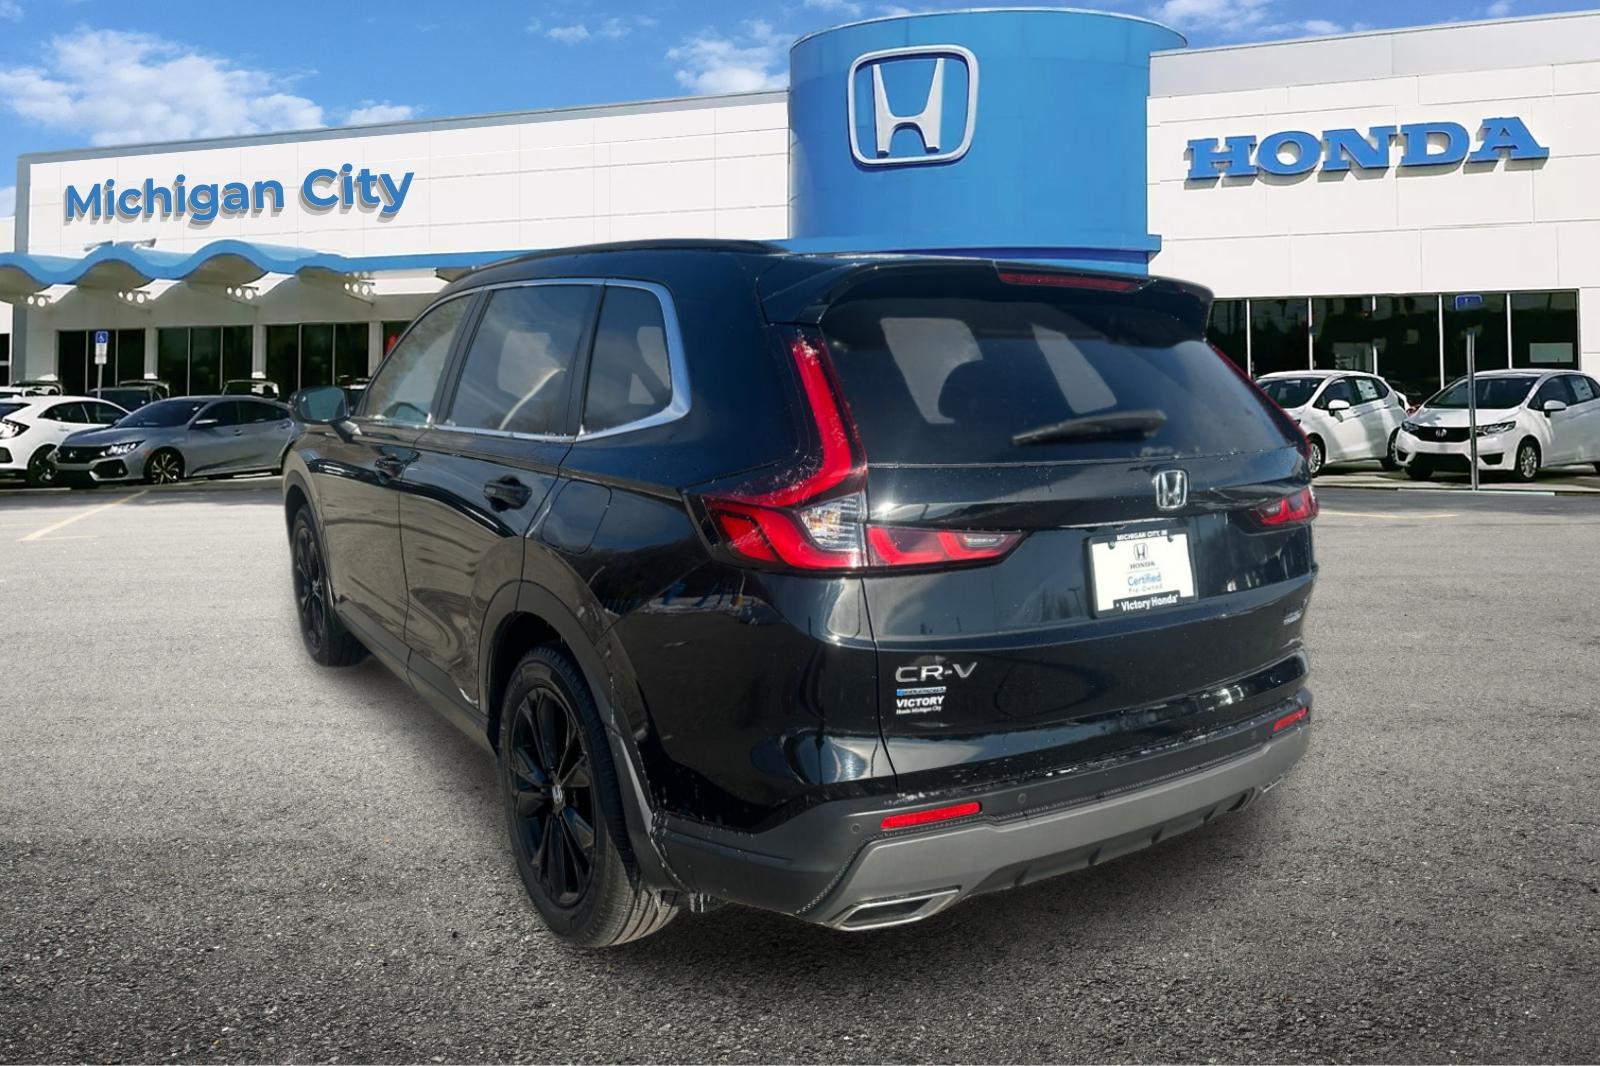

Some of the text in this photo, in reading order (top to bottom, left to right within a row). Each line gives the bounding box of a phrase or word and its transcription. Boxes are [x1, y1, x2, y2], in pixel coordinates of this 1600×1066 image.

[1186, 116, 1550, 181] HONDA
[65, 163, 415, 222] Michigan City
[1130, 561, 1155, 569] HONDA
[1127, 572, 1162, 586] Certified
[1121, 594, 1177, 611] Victory Honda
[895, 662, 978, 682] CR-V
[896, 695, 945, 708] VICTORY
